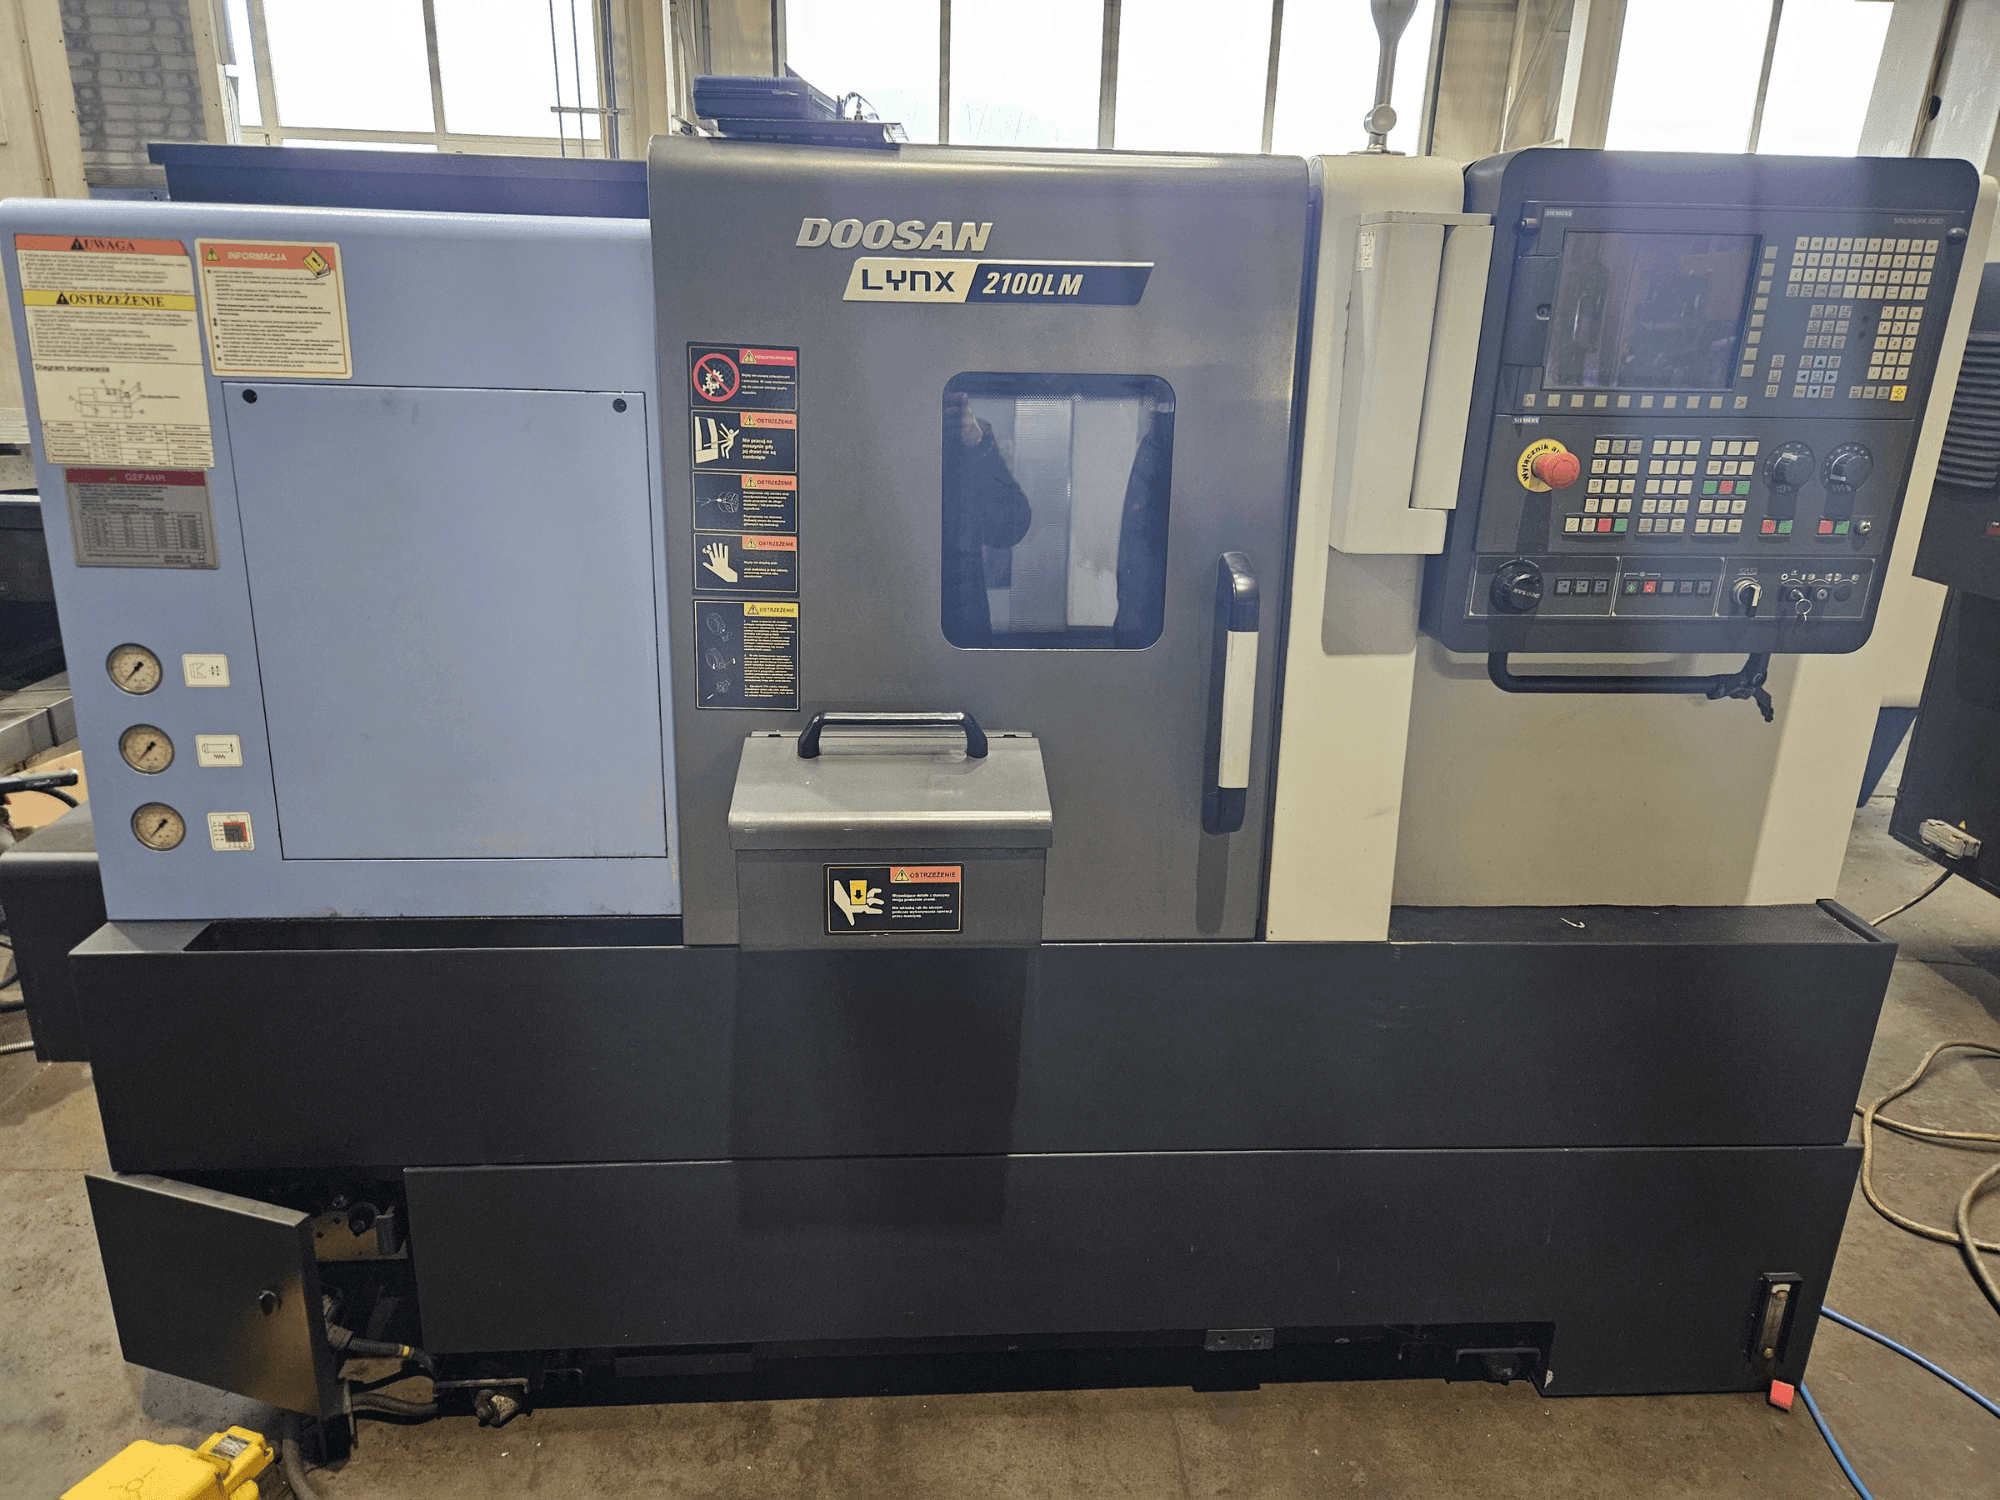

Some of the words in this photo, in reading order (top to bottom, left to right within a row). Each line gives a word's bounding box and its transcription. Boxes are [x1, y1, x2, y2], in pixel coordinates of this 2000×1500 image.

[795, 217, 993, 251] DOOSAN
[84, 239, 135, 251] UWAGA
[227, 252, 287, 261] INFORMACJA
[982, 272, 1084, 296] 2100LM
[69, 293, 165, 307] OSTRZEŻENIE
[35, 363, 65, 372] Diagram
[1522, 444, 1548, 481] Wyłącznik
[124, 473, 166, 481] GEFAHR
[1513, 588, 1540, 598] DOOSAN
